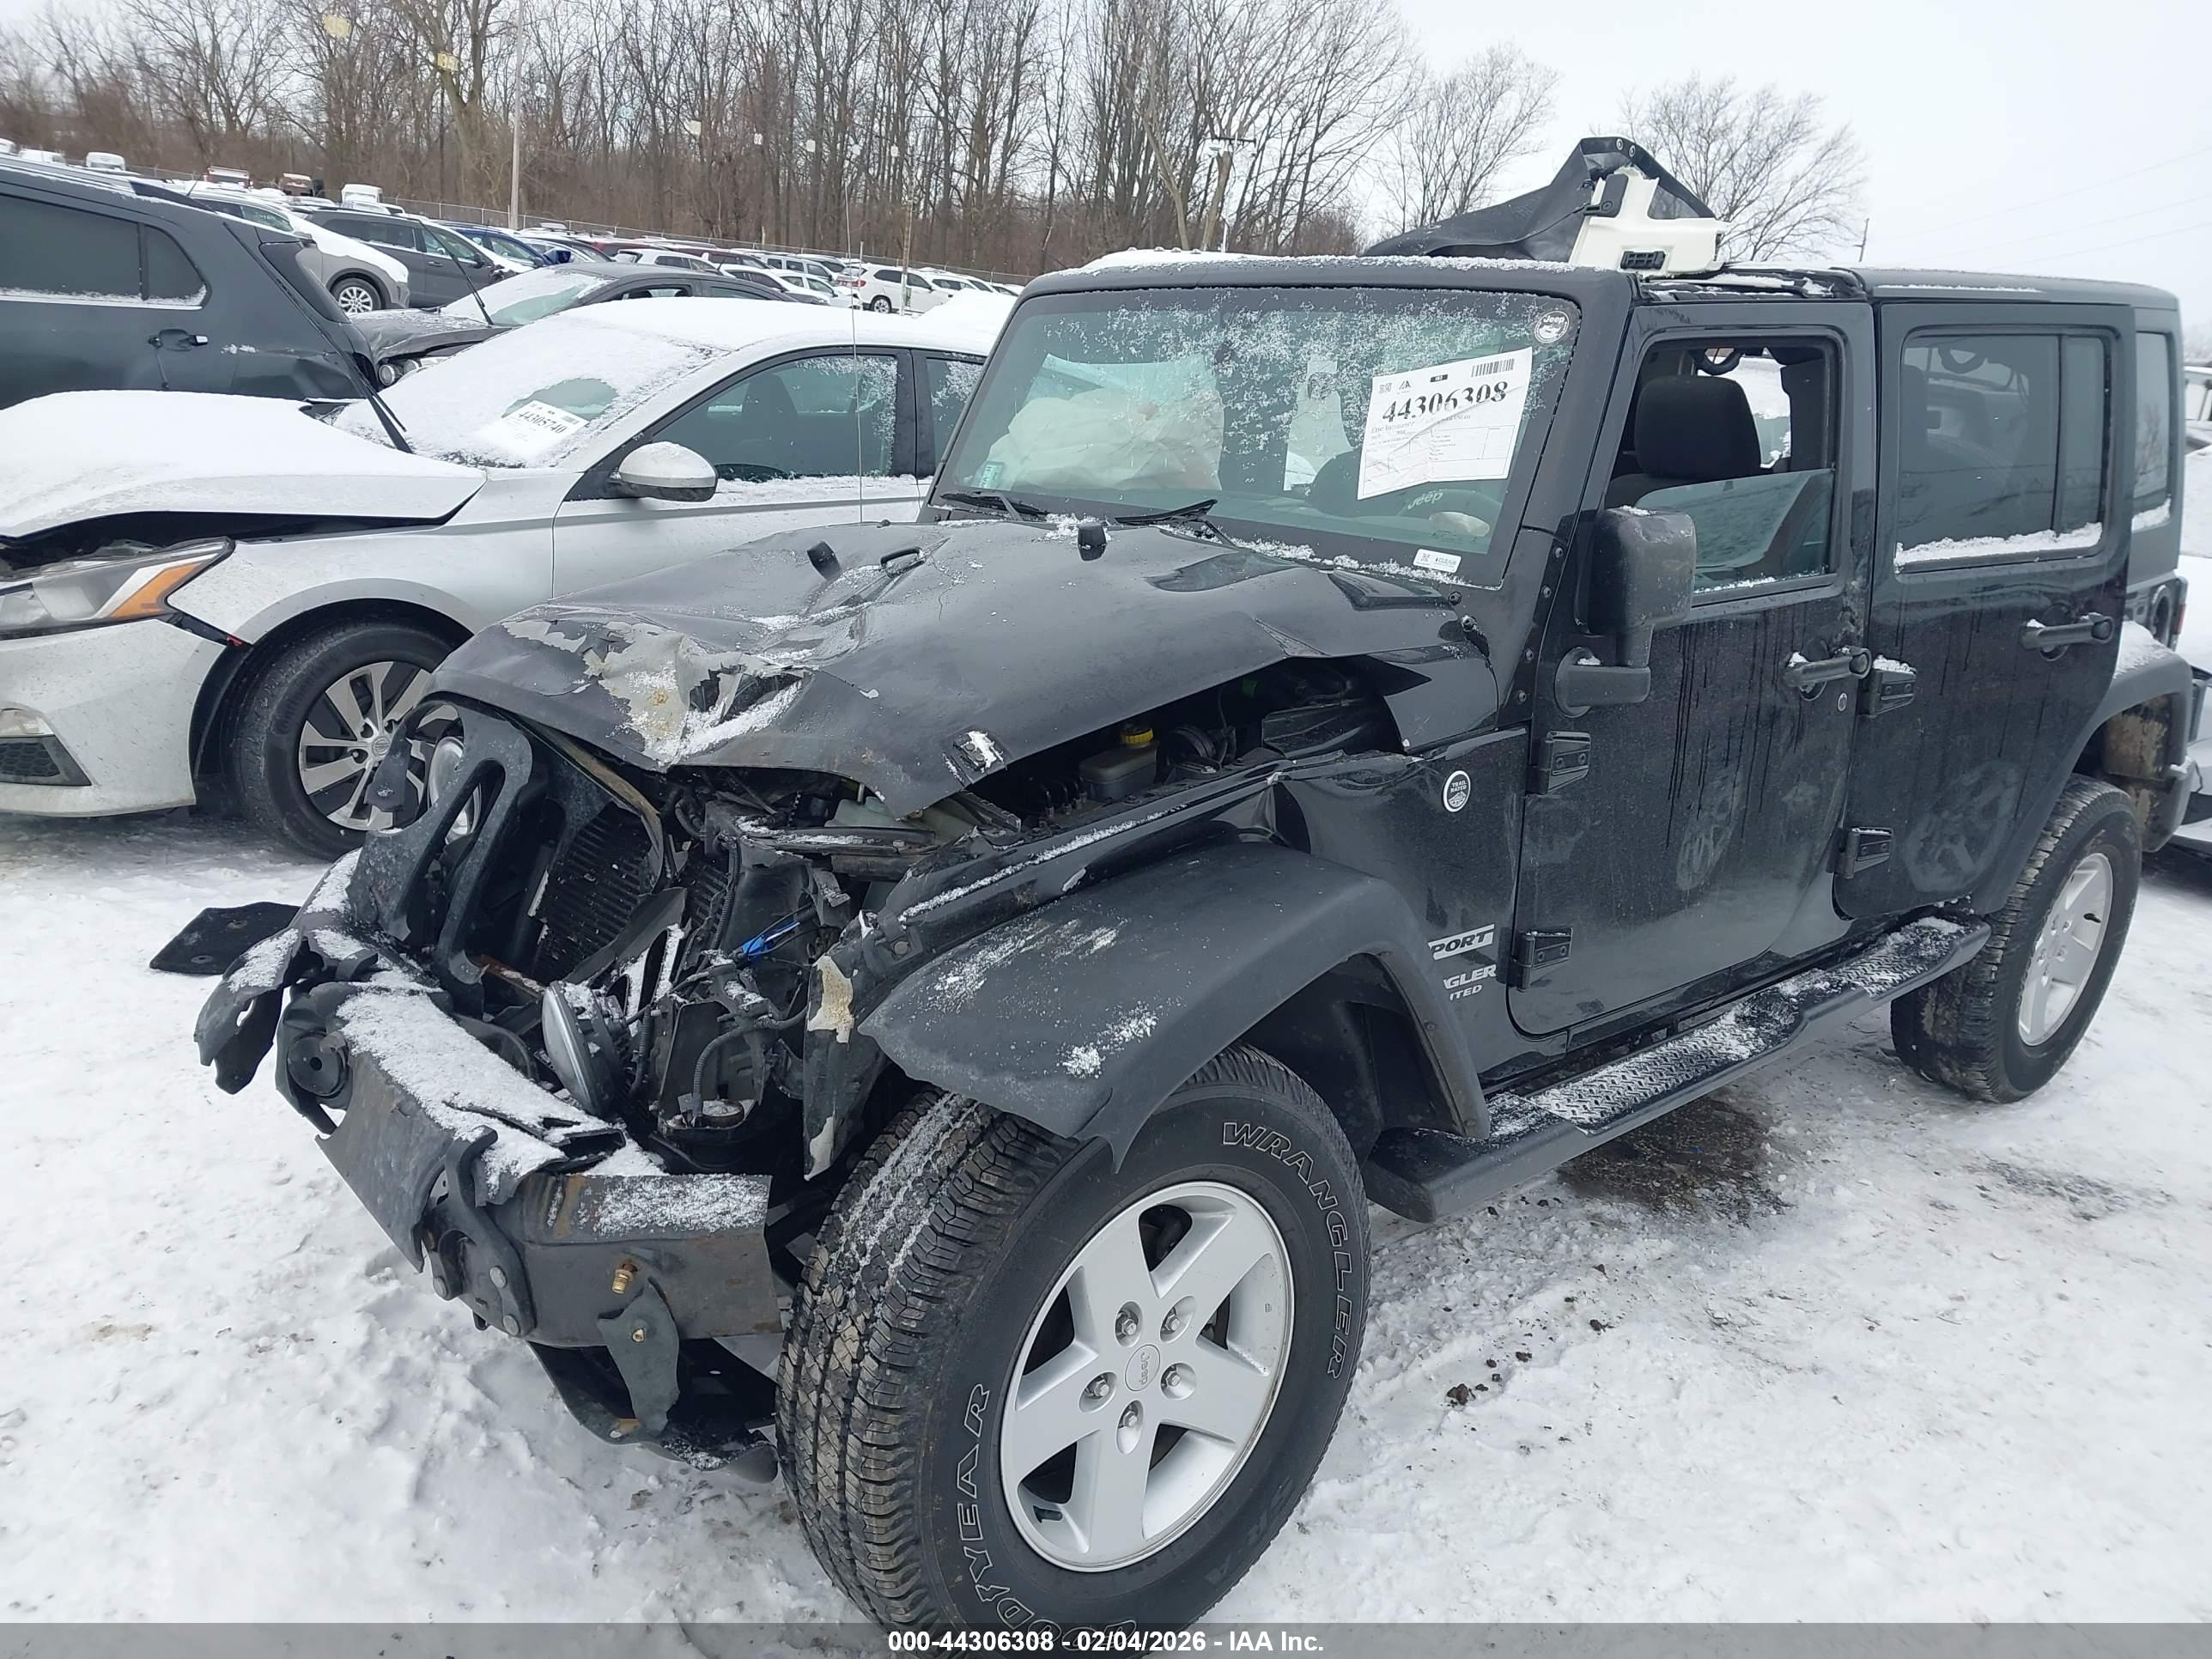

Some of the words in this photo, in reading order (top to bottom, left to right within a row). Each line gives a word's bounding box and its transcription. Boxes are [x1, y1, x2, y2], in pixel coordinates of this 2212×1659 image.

[1543, 315, 1565, 325] Jeep
[1382, 380, 1509, 422] 44306308
[518, 410, 568, 434] 44305740
[1407, 492, 1443, 510] Jeep
[1222, 1121, 1353, 1379] WRANGLER
[1139, 1352, 1151, 1386] Jeep
